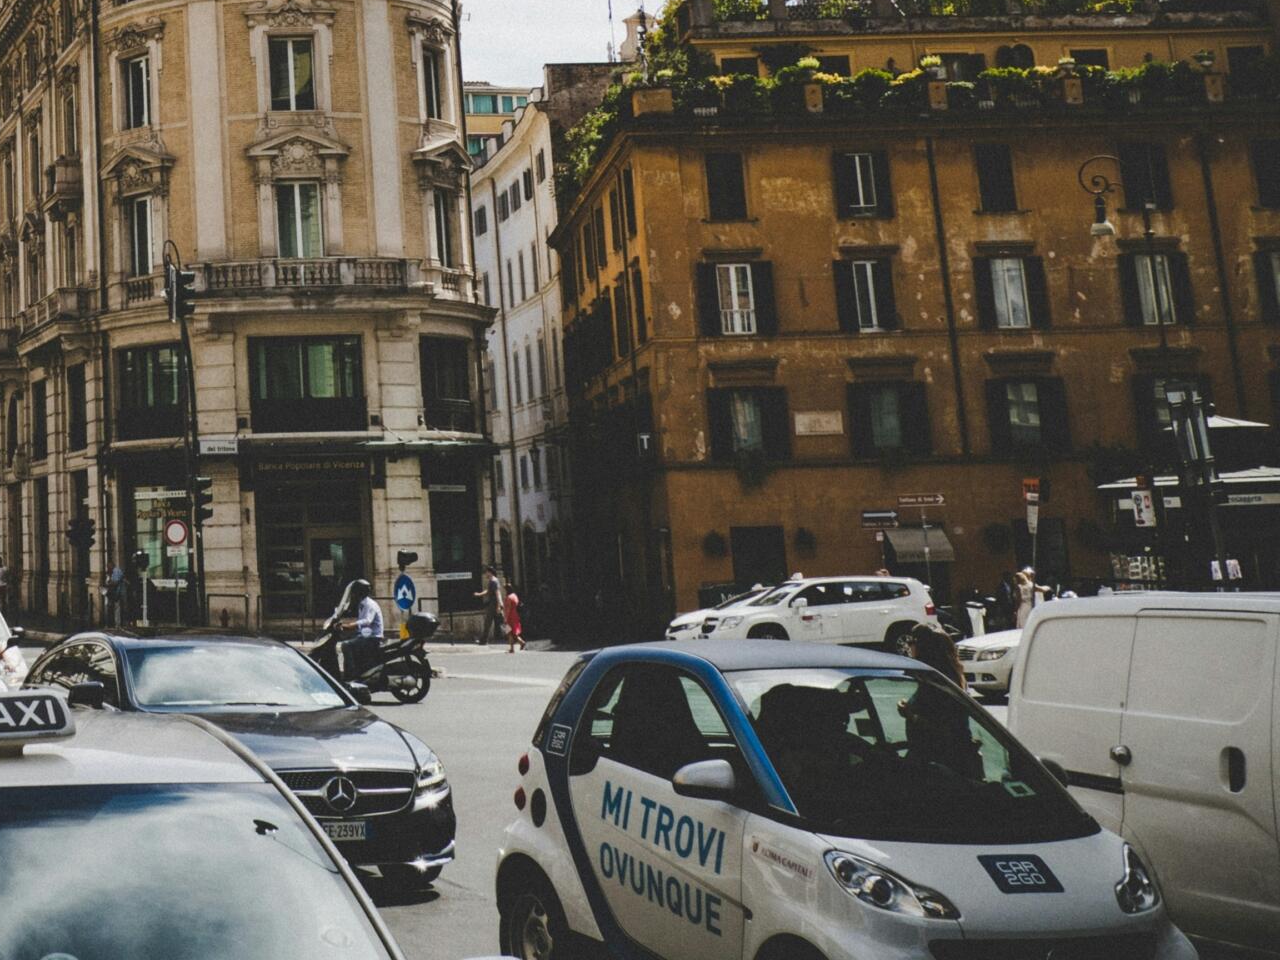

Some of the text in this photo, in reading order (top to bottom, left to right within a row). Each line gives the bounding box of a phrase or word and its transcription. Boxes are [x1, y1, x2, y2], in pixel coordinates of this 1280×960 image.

[601, 780, 725, 875] MI TROVI
[600, 842, 722, 937] OVUNQUE
[996, 861, 1038, 873] CAR
[1004, 873, 1046, 885] 2GO
